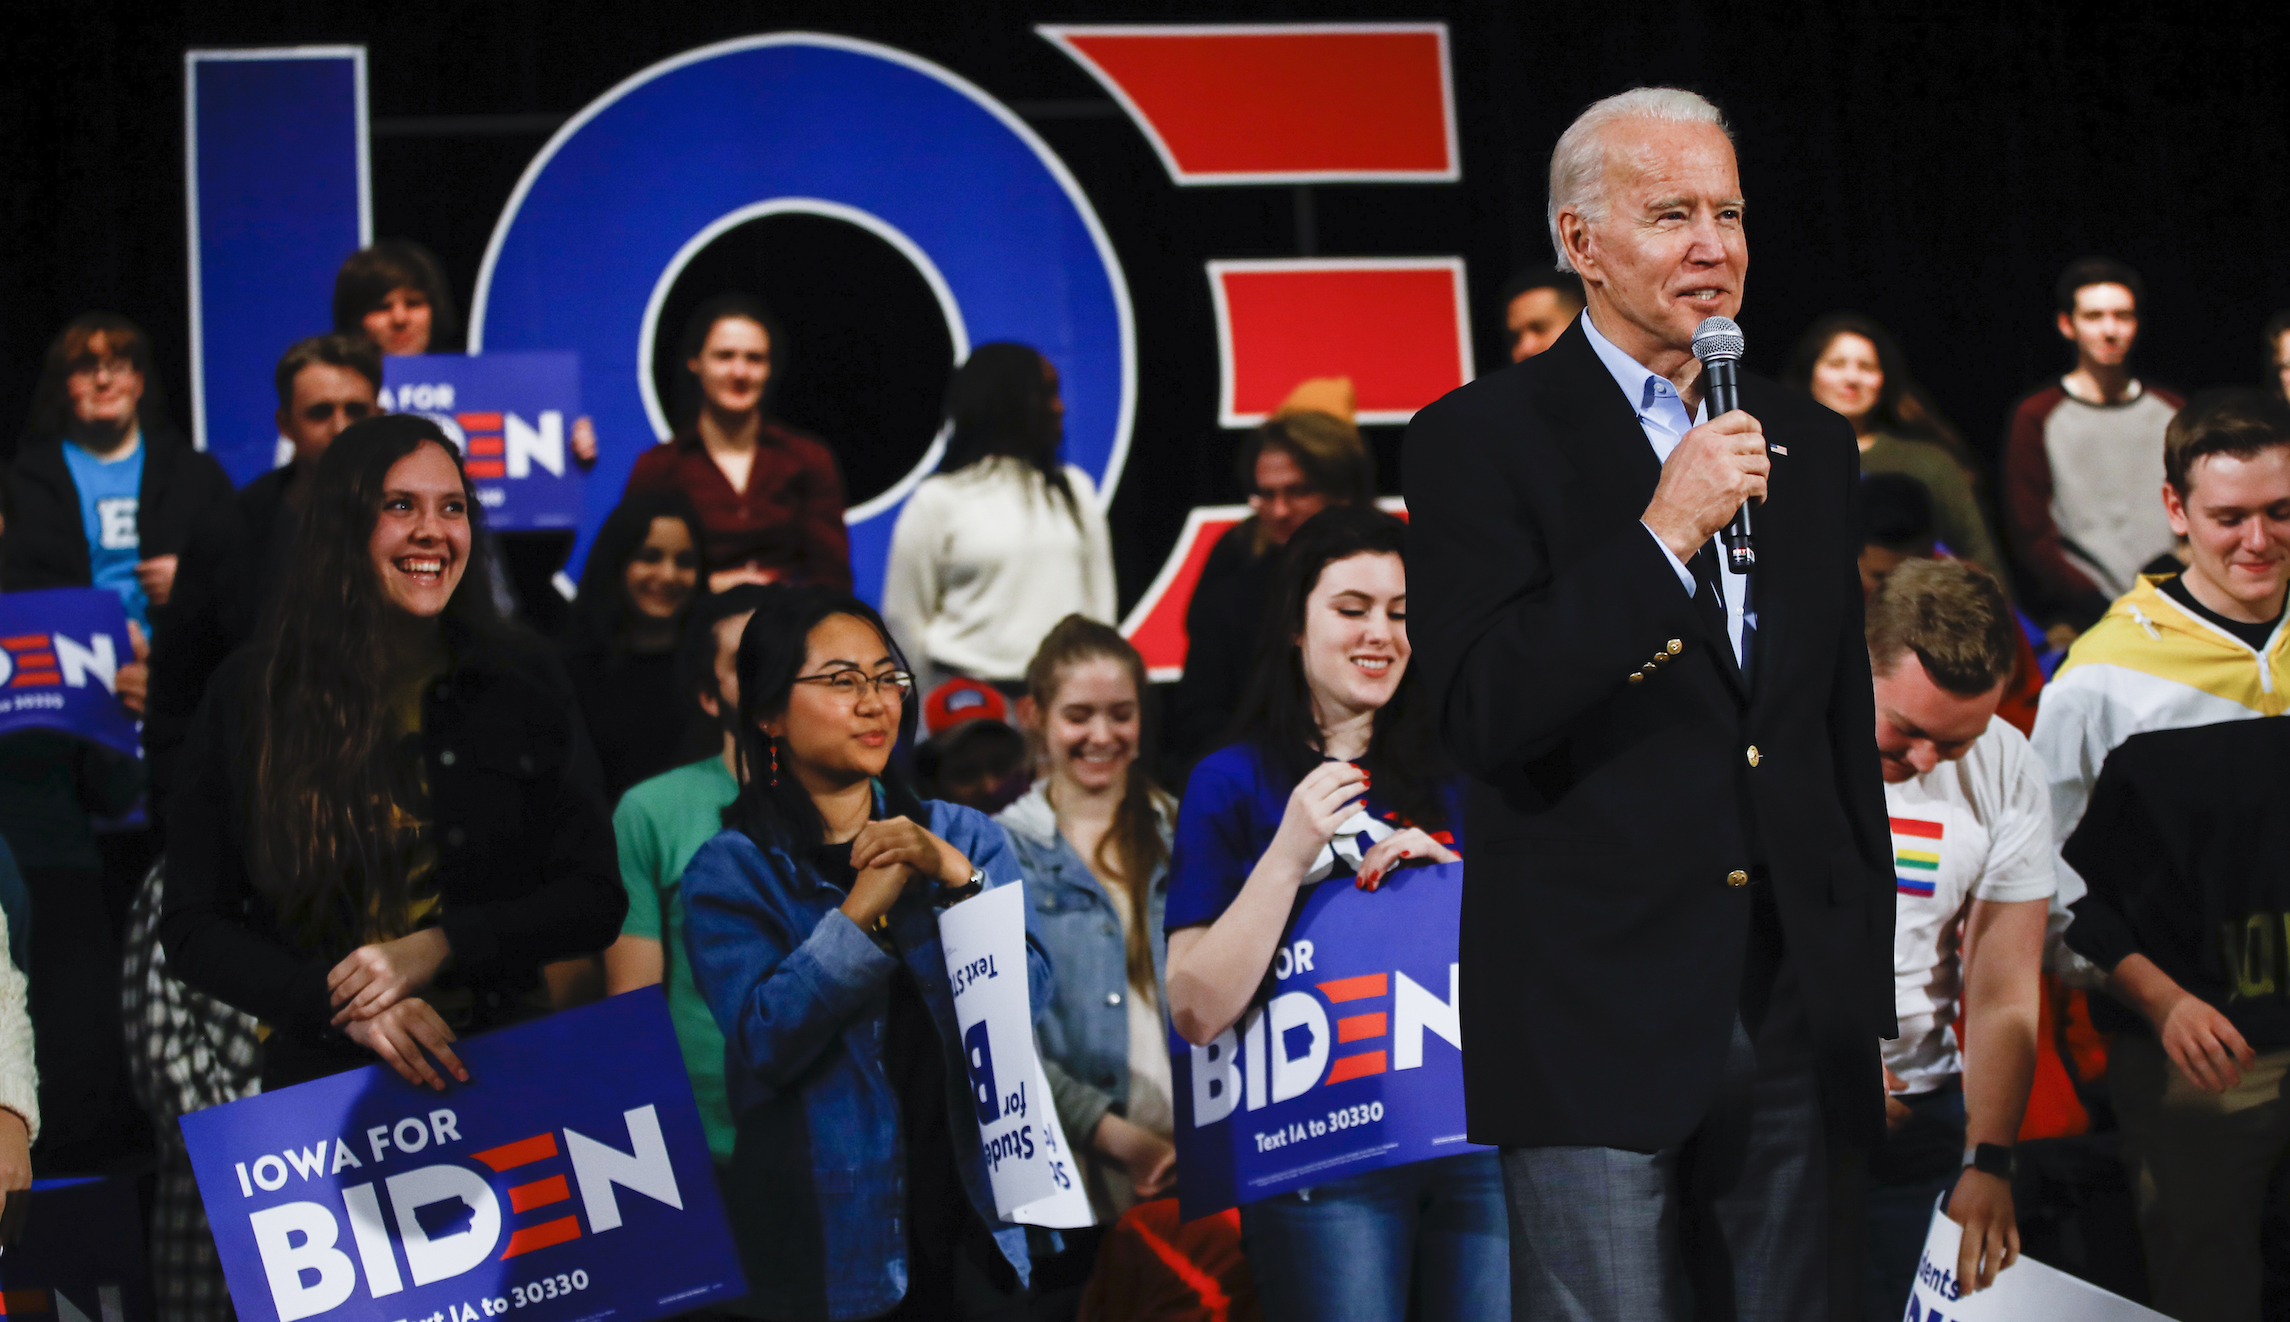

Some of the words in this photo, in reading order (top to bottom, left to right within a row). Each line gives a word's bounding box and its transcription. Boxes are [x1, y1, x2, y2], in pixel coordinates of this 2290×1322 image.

[398, 383, 455, 410] FOR
[965, 954, 998, 986] Text
[1275, 939, 1315, 981] OR
[1190, 962, 1462, 1129] BIDEN
[1004, 1081, 1026, 1119] for
[1254, 1132, 1288, 1153] Text
[1288, 1123, 1307, 1143] IA
[1308, 1119, 1327, 1138] to
[1327, 1101, 1384, 1133] 30330
[235, 1137, 362, 1198] IOWA
[367, 1108, 462, 1163] FOR
[249, 1103, 684, 1322] BIDEN
[481, 1297, 508, 1317] to
[511, 1269, 589, 1308] 30330
